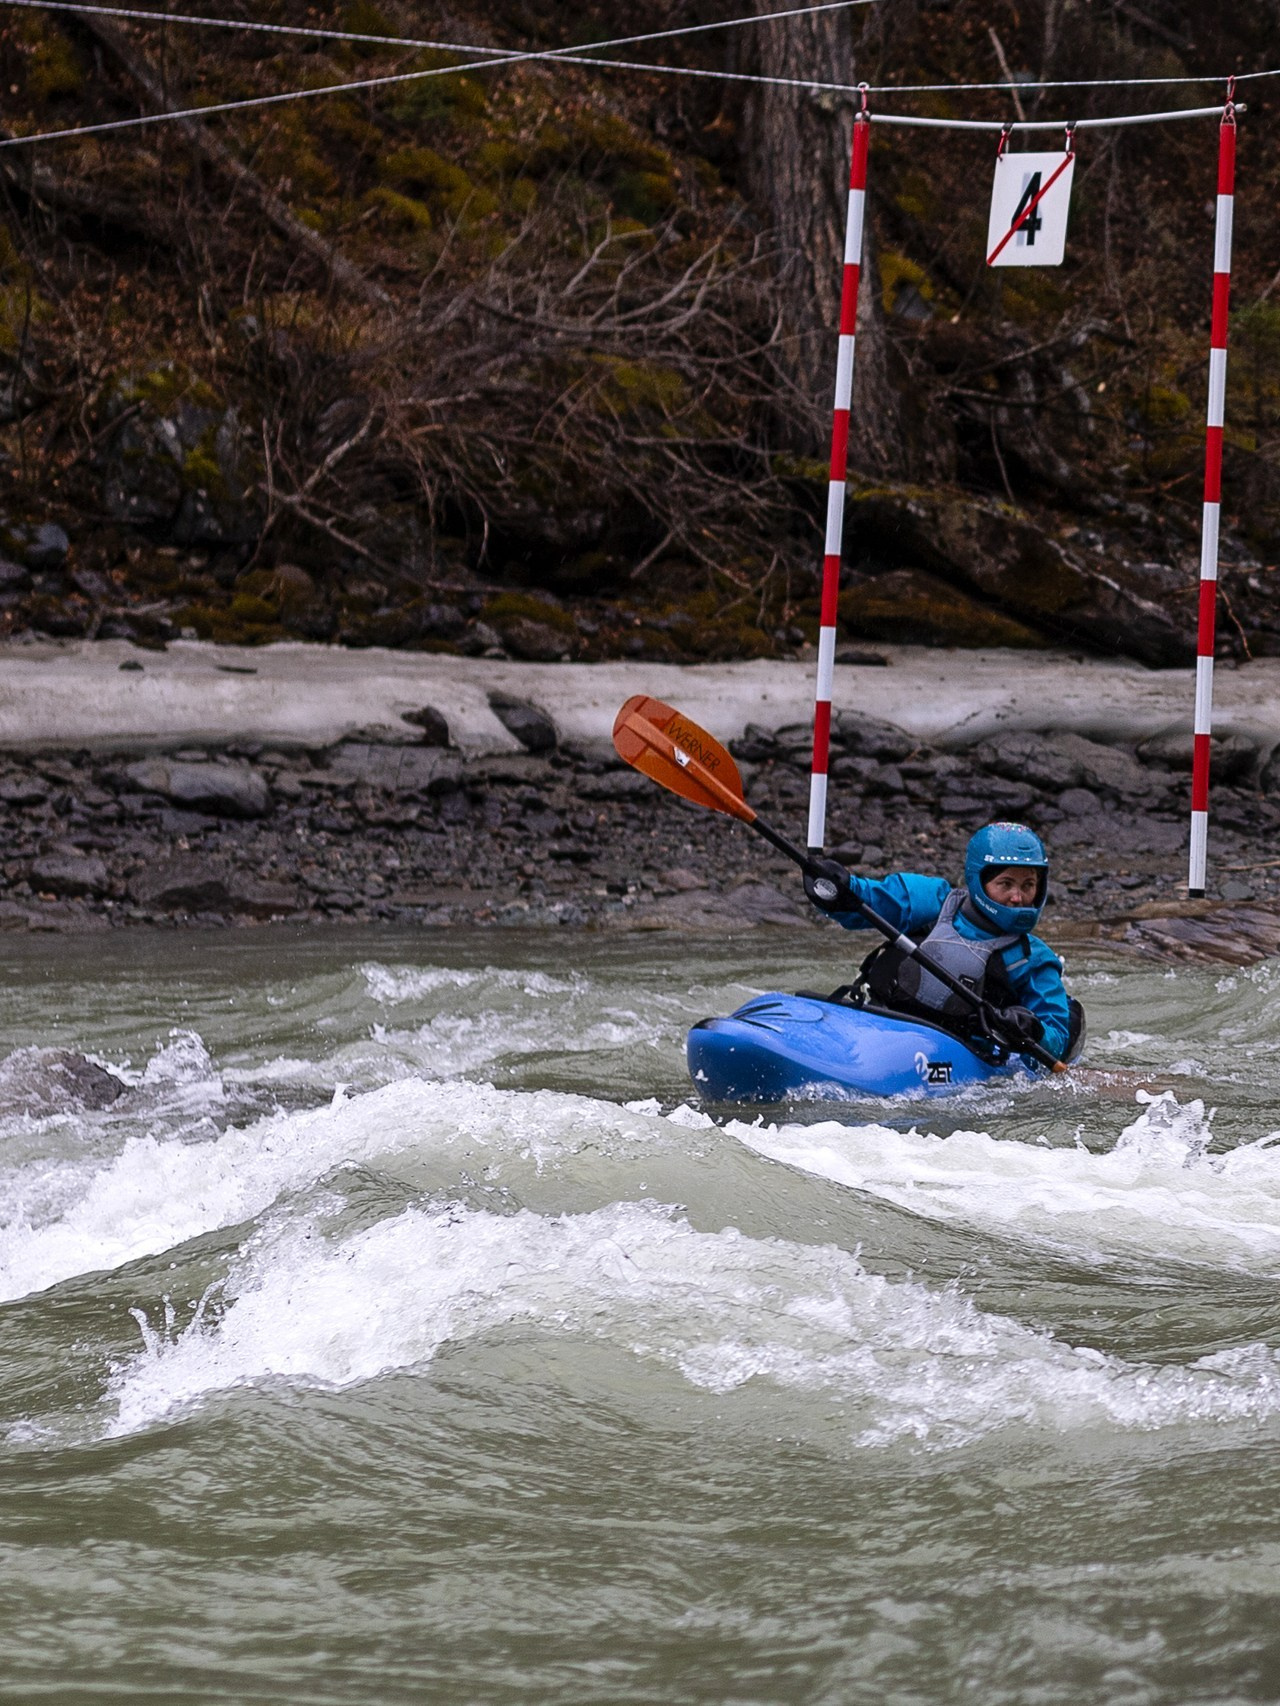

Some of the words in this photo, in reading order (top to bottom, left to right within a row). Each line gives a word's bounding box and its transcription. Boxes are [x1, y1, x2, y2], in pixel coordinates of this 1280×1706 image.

[1011, 171, 1042, 246] 4
[669, 721, 720, 771] WERNER
[927, 1061, 953, 1084] ZET
